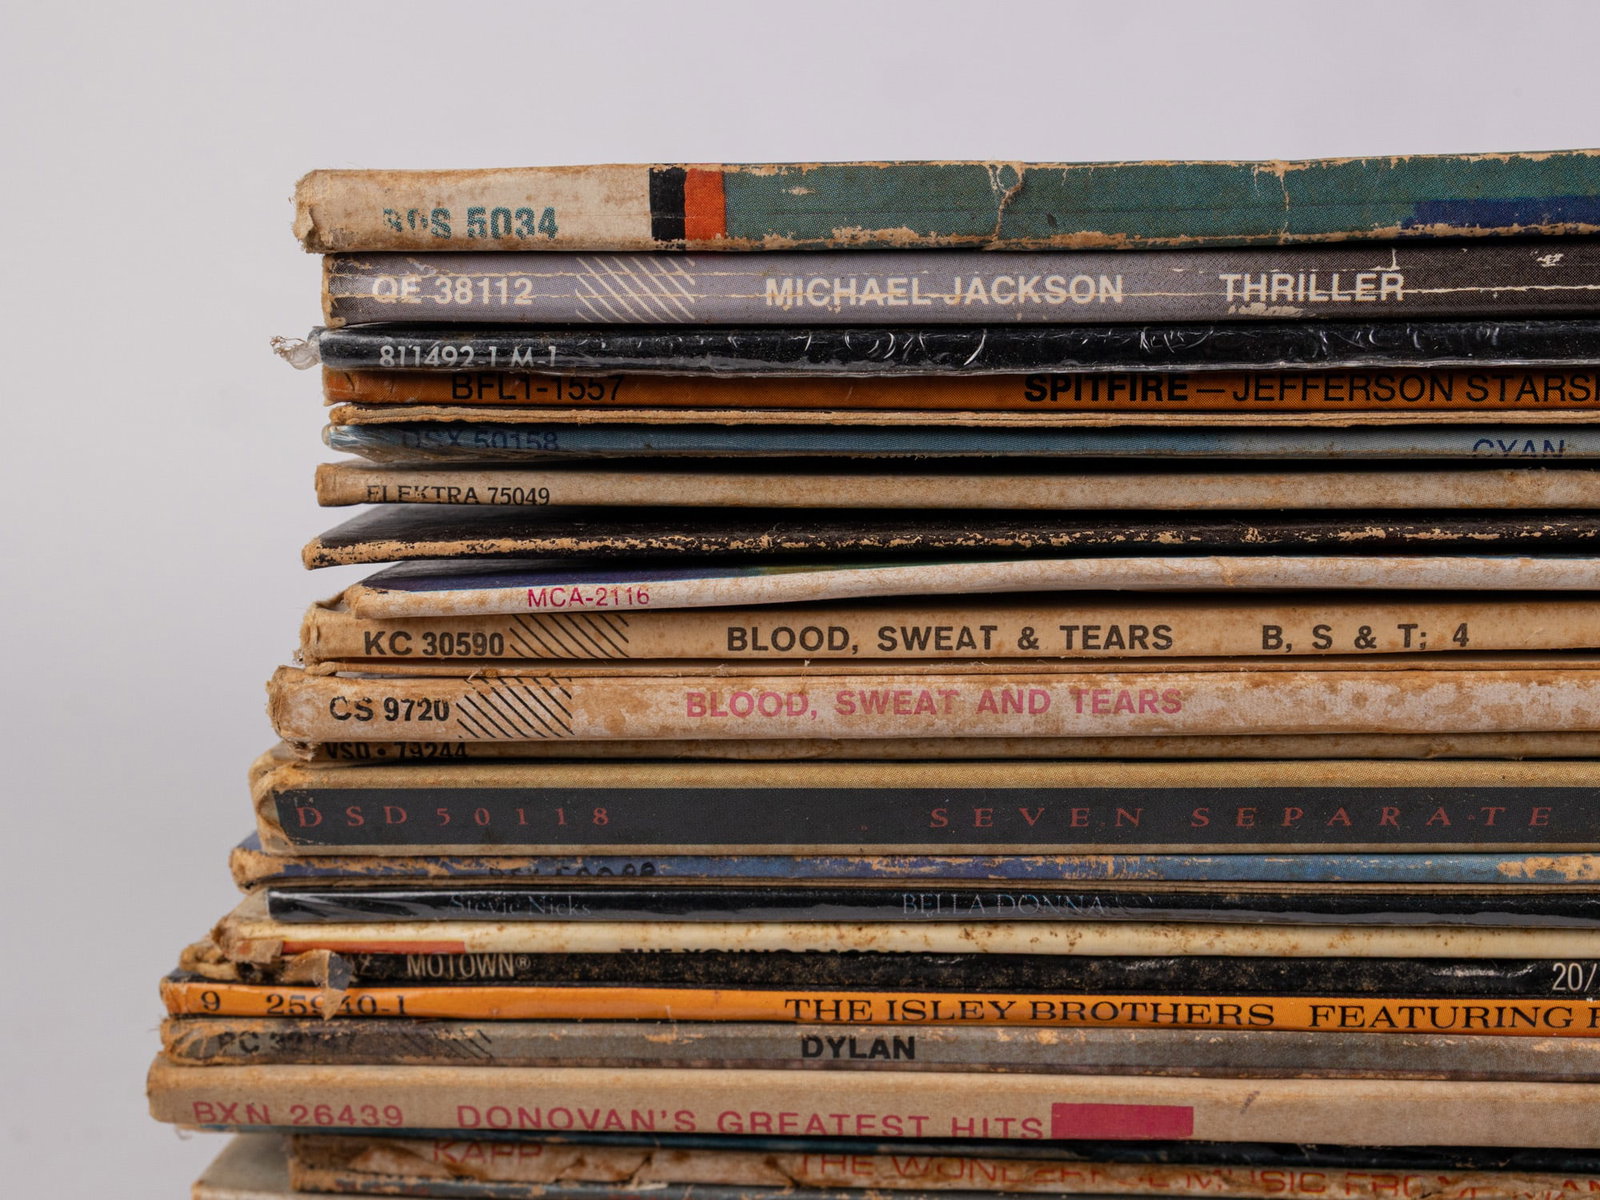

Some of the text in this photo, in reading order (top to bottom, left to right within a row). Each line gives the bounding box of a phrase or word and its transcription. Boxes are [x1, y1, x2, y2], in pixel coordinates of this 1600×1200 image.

[466, 206, 559, 240] 5034
[371, 276, 533, 305] QE 38112
[764, 274, 1124, 308] MICHAEL JACKSON
[1219, 272, 1405, 303] THRILLER
[379, 345, 557, 368] 811492-1 M-1
[451, 374, 624, 402] BFL1-1557
[1024, 373, 1189, 403] SPITFIRE
[1233, 373, 1454, 402] JEFFERSON
[473, 430, 560, 451] 50158
[366, 484, 551, 506] ELEKTRA 75049
[527, 586, 651, 608] MCA-2116
[364, 631, 505, 657] KC 30590
[727, 623, 1174, 655] BLOOD, SWEAT & TEARS
[1262, 624, 1293, 654] B,
[1311, 623, 1334, 650] S
[1353, 624, 1378, 650] &
[1452, 622, 1470, 648] 4
[328, 696, 451, 723] CS 9720
[686, 688, 1183, 721] BLOOD, SWEAT AND TEARS
[447, 893, 592, 917] Stevie Nicks
[901, 893, 1106, 917] BELLA DONNA
[1551, 961, 1600, 993] 20/
[200, 990, 222, 1012] 9
[784, 998, 873, 1023] THE
[887, 999, 1017, 1023] ISLEY
[1028, 1000, 1275, 1027] BROTHERS
[1308, 1003, 1574, 1029] FEATURING
[801, 1035, 916, 1060] DYLAN
[191, 1100, 405, 1127] BXN 26439
[457, 1105, 1044, 1140] DONOVAN'S GREATEST HITS
[801, 1154, 875, 1176] THE
[1185, 1168, 1328, 1195] MSIC
